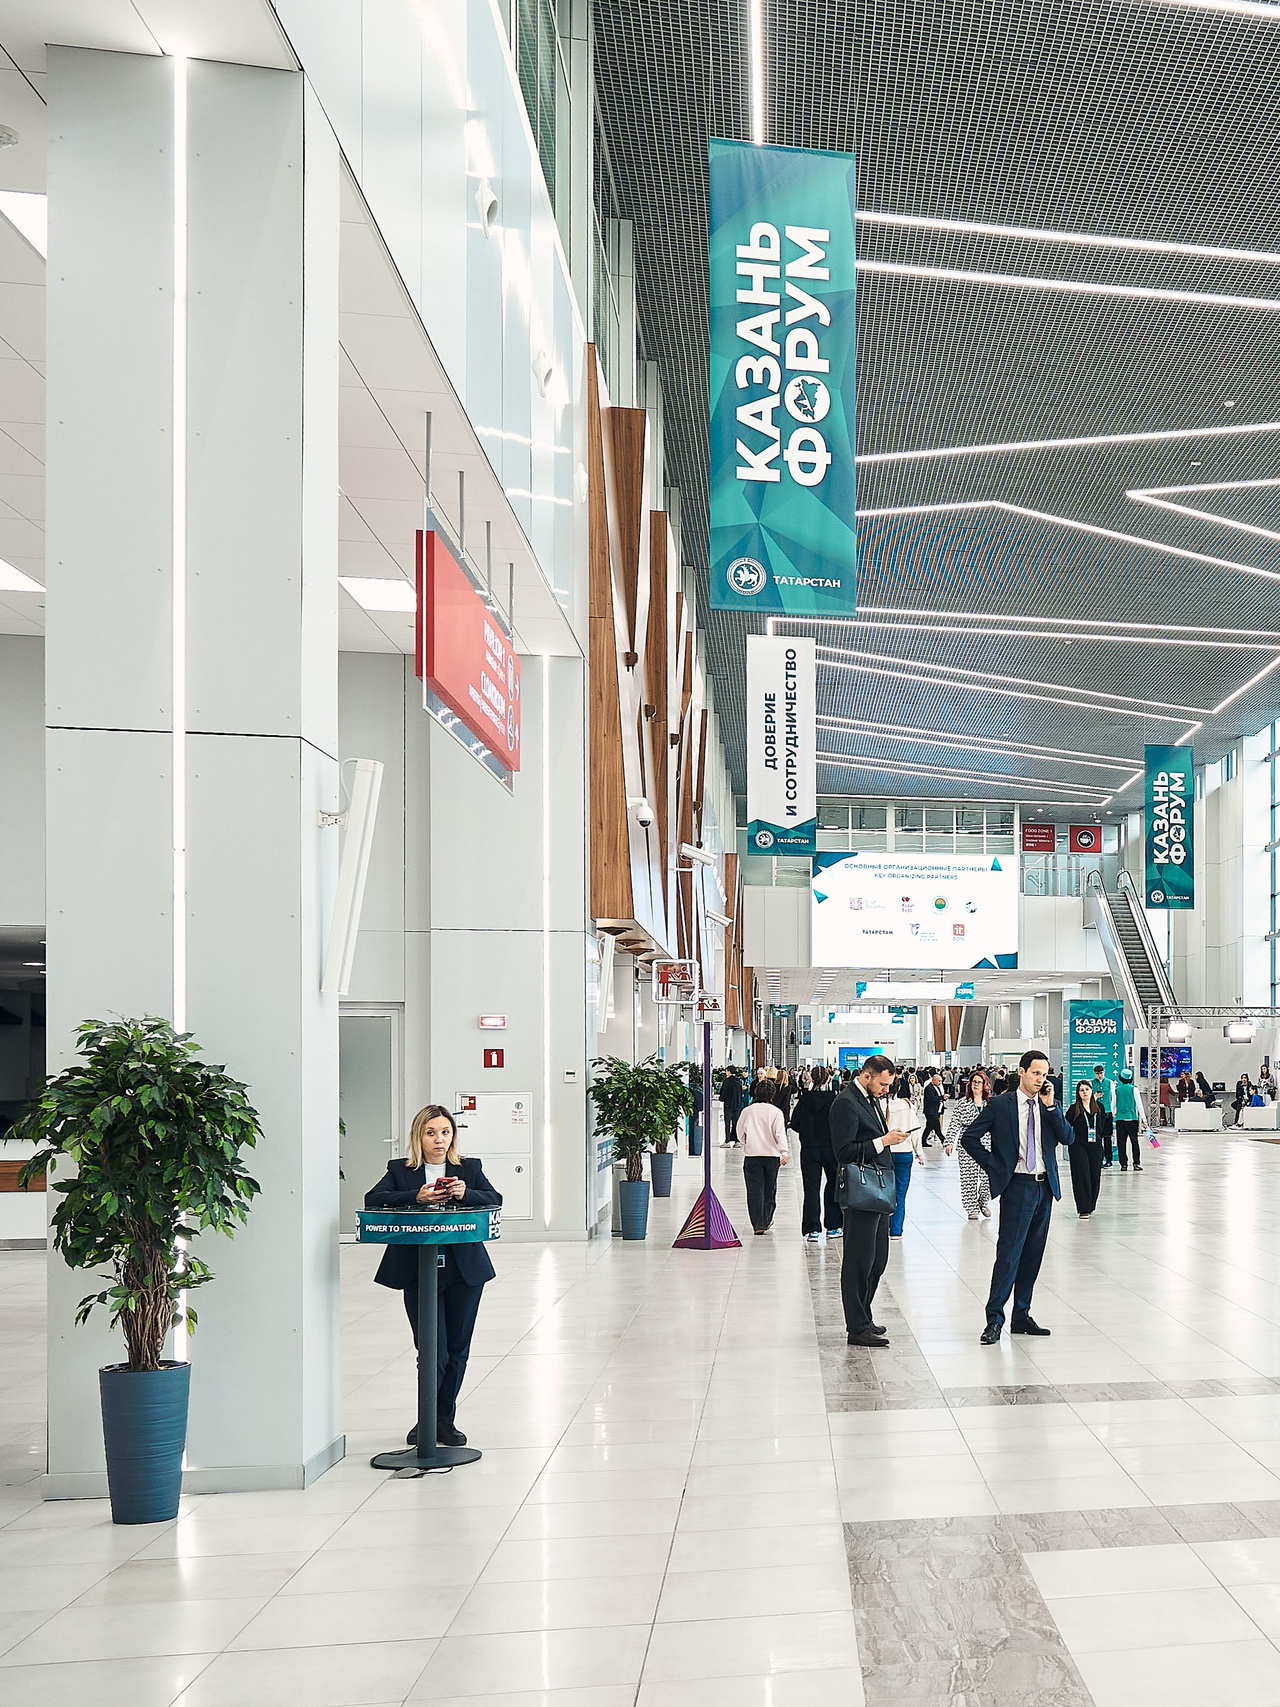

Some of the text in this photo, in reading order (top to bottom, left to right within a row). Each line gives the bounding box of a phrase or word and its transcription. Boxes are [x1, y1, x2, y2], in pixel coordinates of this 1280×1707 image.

[735, 221, 782, 483] КАЗАНЬ
[783, 225, 832, 488] ФОРУМ
[773, 574, 842, 588] ТАТАРСТАН
[764, 692, 778, 770] ДОВЕРИЕ
[785, 648, 799, 816] И СОТРУДНИЧЕСТВО
[1153, 771, 1170, 864] КАЗАНЬ
[1169, 772, 1186, 865] ФОРУМ
[1075, 1018, 1117, 1027] КАЗАНЬ
[1075, 1026, 1117, 1034] ФОРУМ
[365, 1224, 388, 1232] POWER
[401, 1223, 476, 1233] TRANSFORMATION
